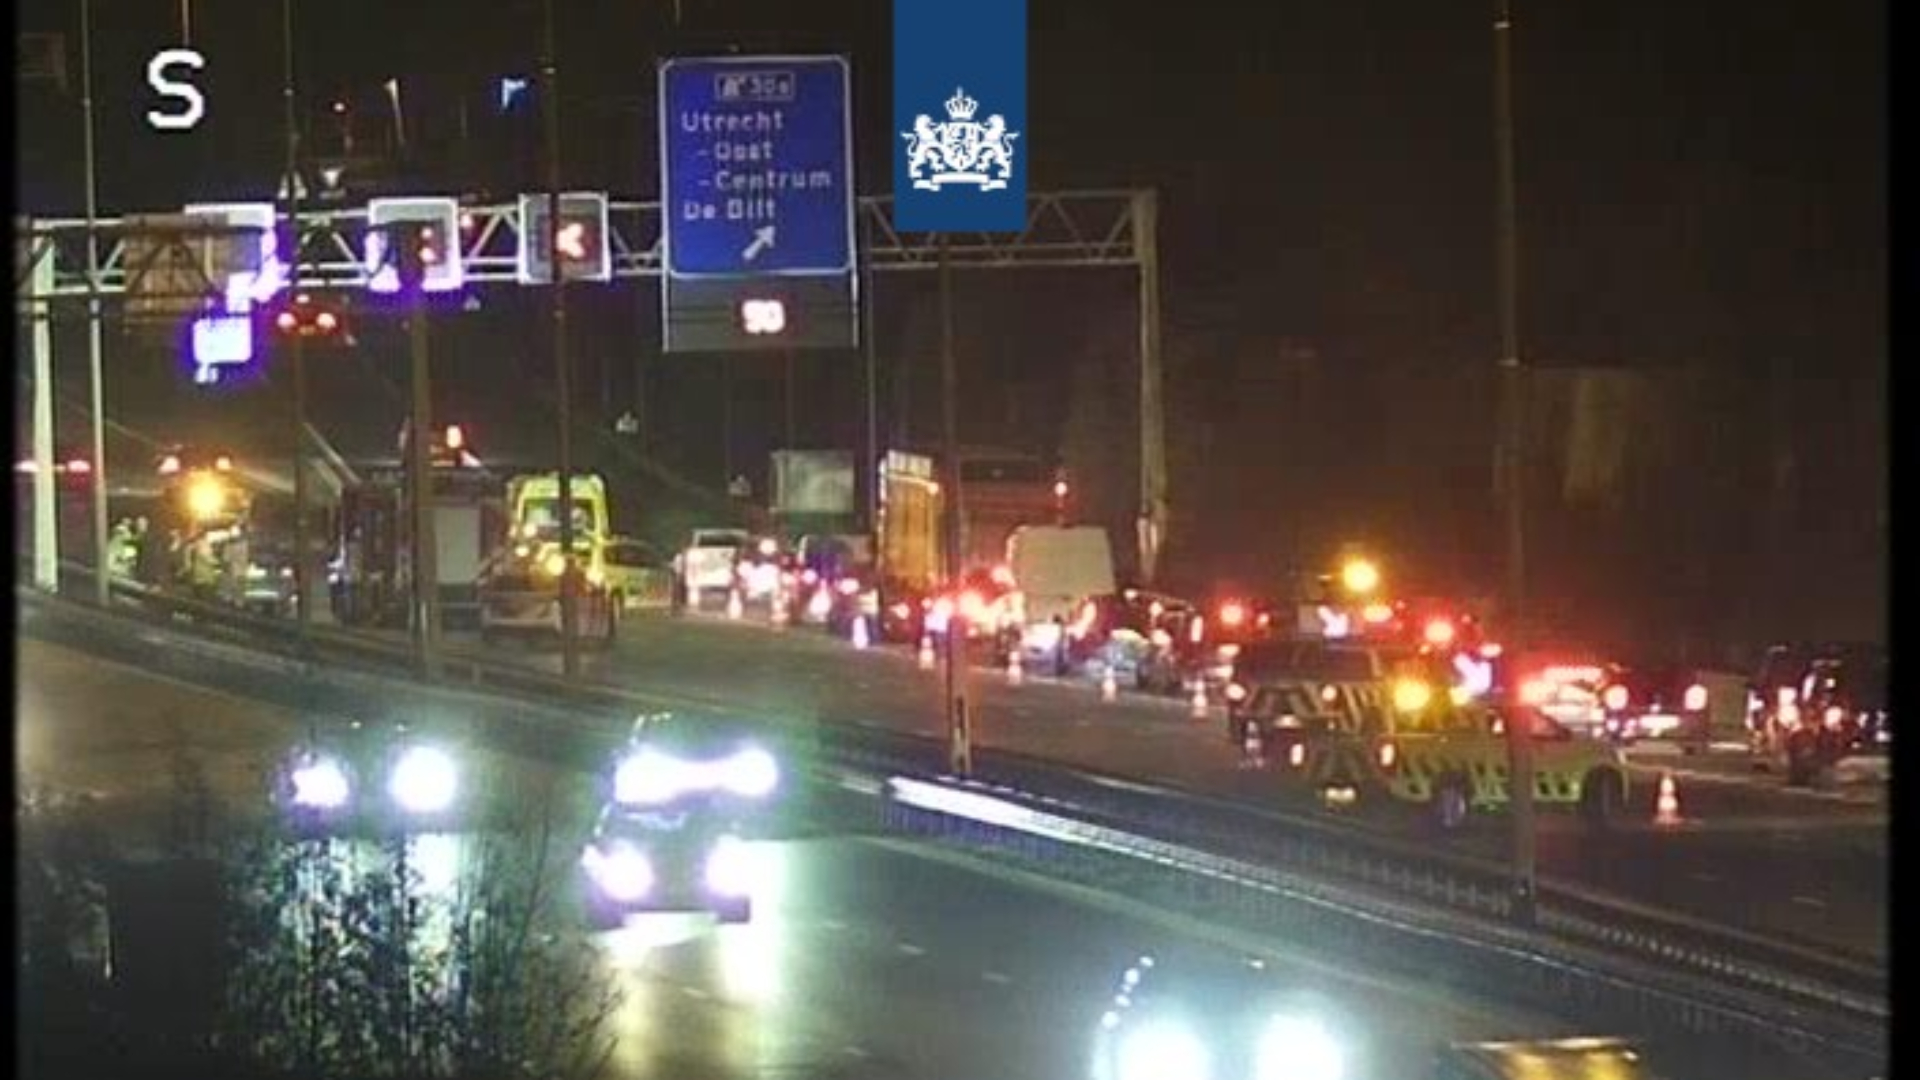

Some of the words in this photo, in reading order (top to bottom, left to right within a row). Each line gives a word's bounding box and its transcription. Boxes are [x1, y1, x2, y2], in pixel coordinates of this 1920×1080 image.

[681, 110, 784, 132] Utrecht
[684, 200, 717, 221] De
[727, 198, 776, 220] Bilt
